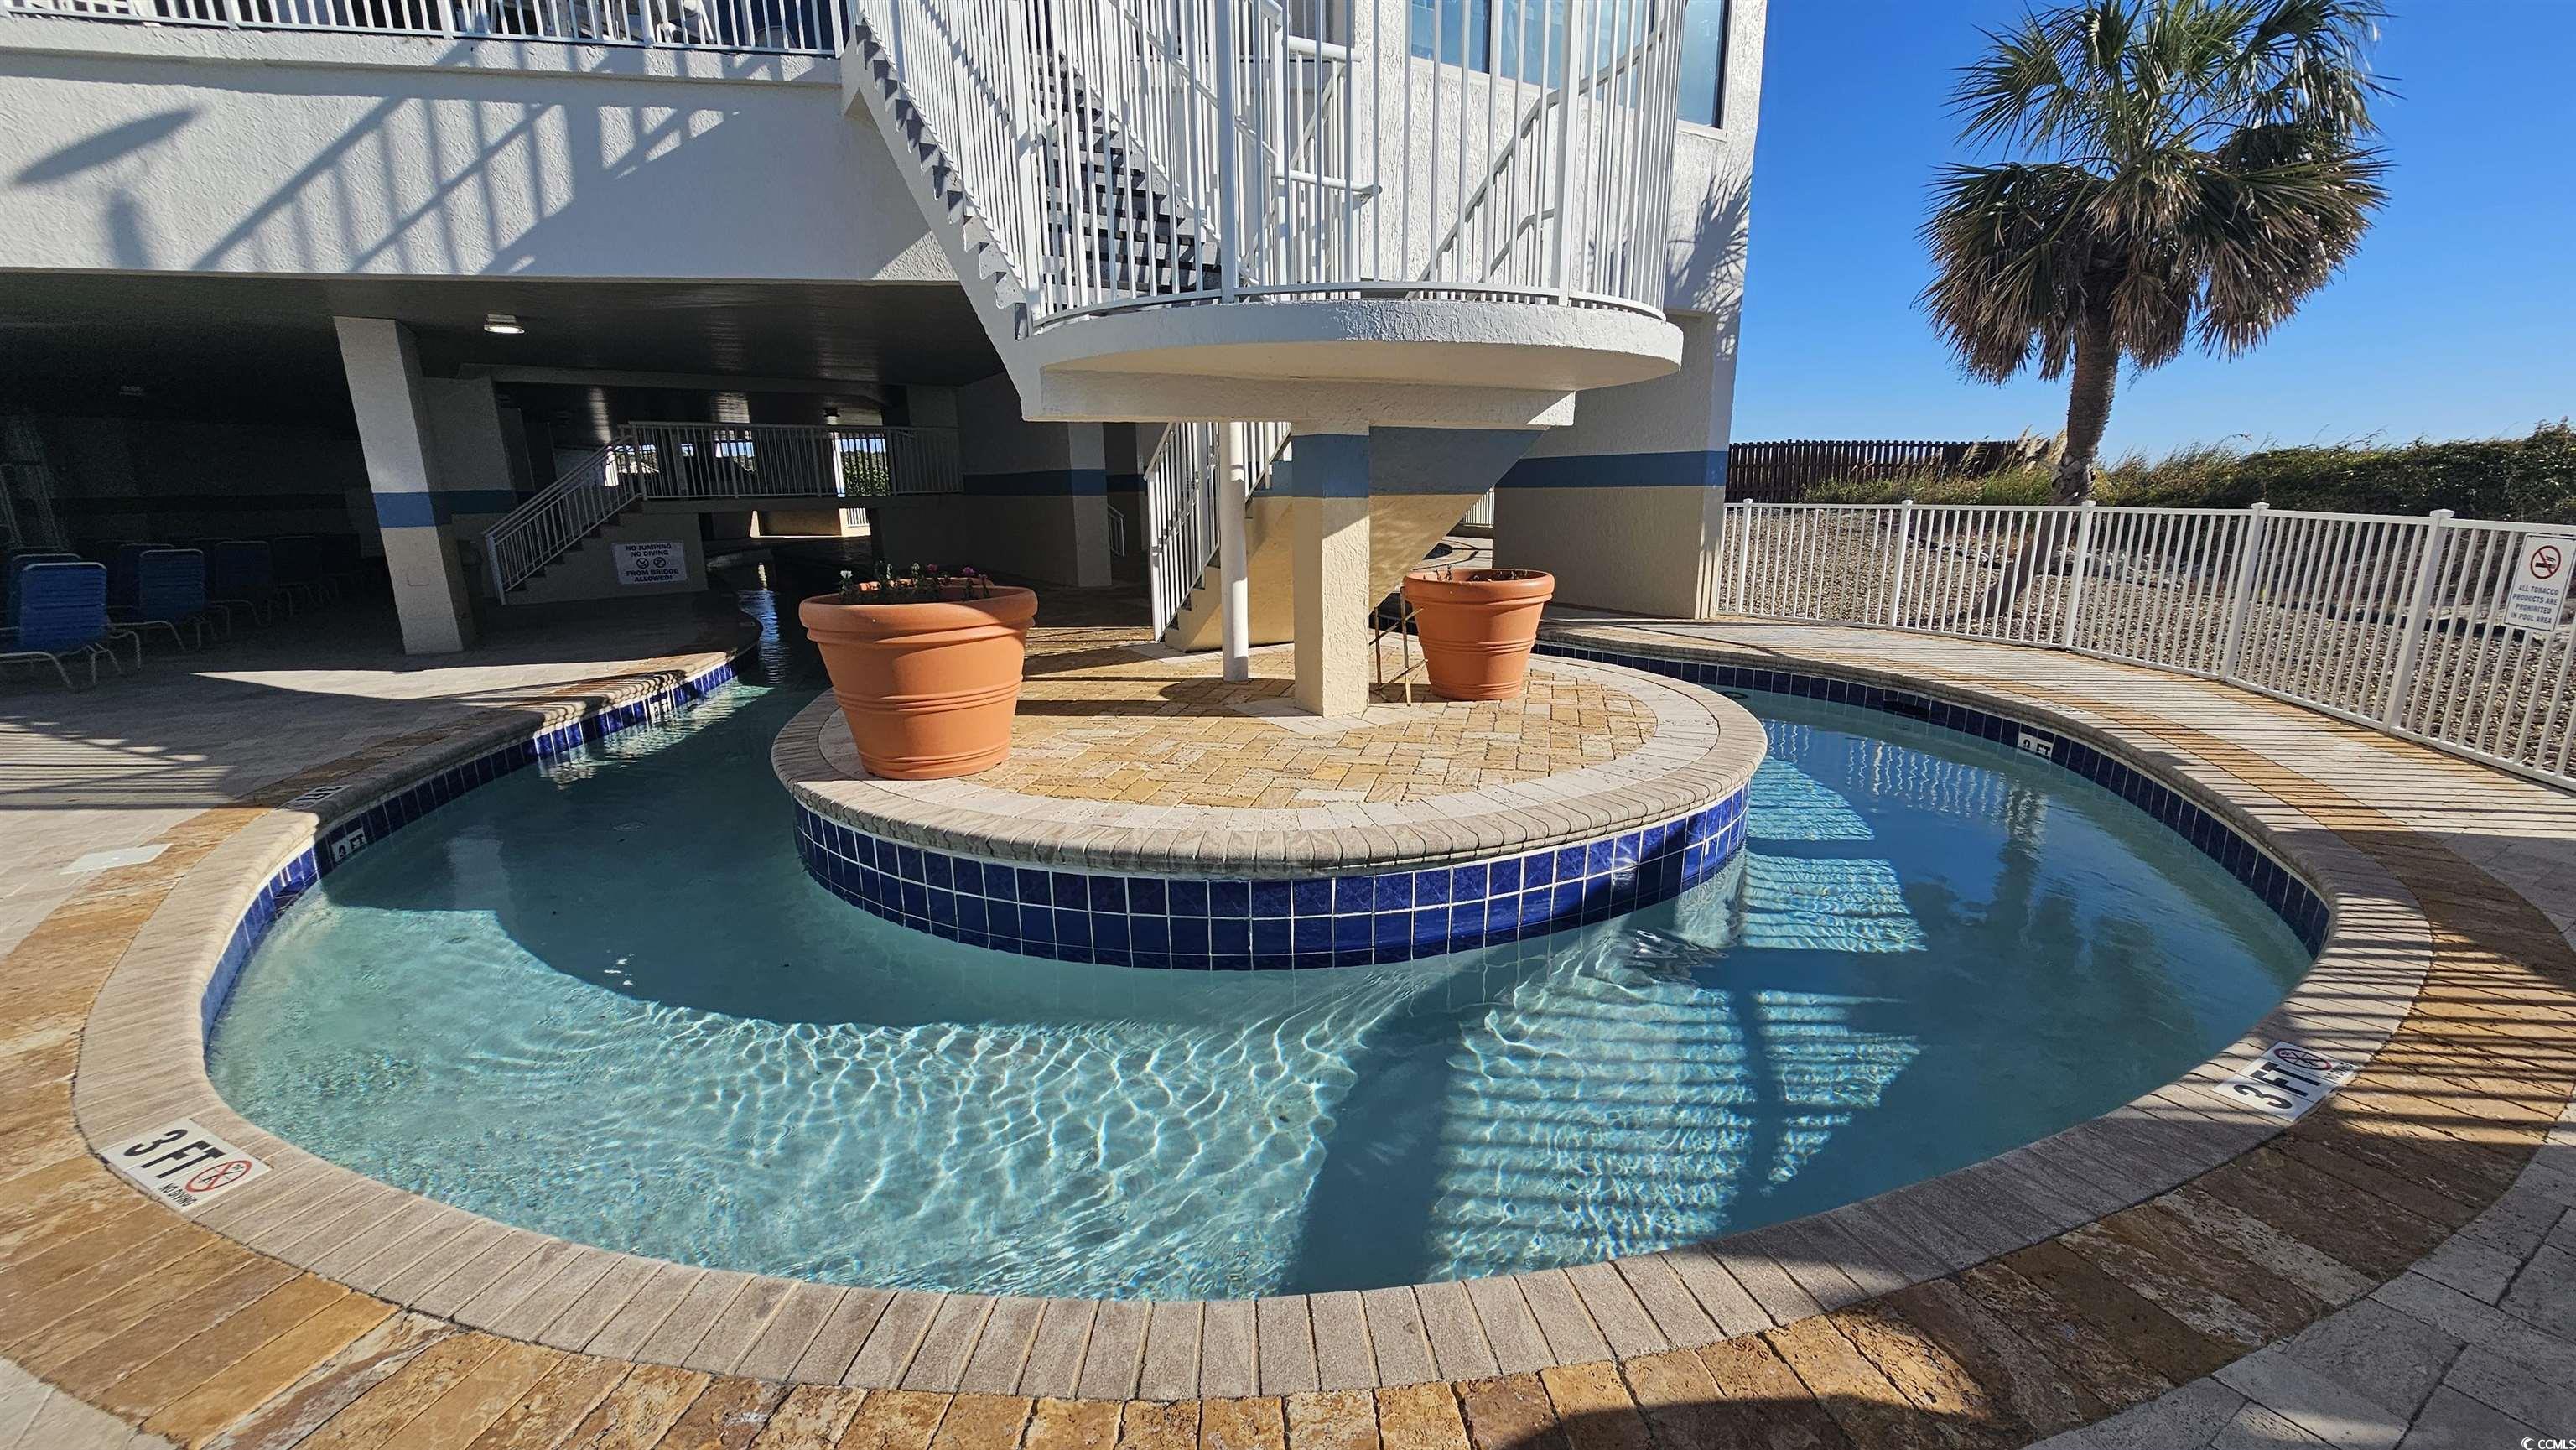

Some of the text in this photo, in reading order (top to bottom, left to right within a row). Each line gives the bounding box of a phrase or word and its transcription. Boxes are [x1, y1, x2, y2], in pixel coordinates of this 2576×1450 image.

[2512, 593, 2558, 605] PRODUCTS ARE
[2531, 585, 2558, 595] TOBACCO
[2515, 603, 2552, 614] PROHIBITED
[2518, 613, 2534, 621] POOL
[2249, 1061, 2321, 1097] FT
[2233, 1084, 2293, 1110] 3
[123, 1129, 226, 1179] 3 FT
[158, 1183, 198, 1207] NO DIVING
